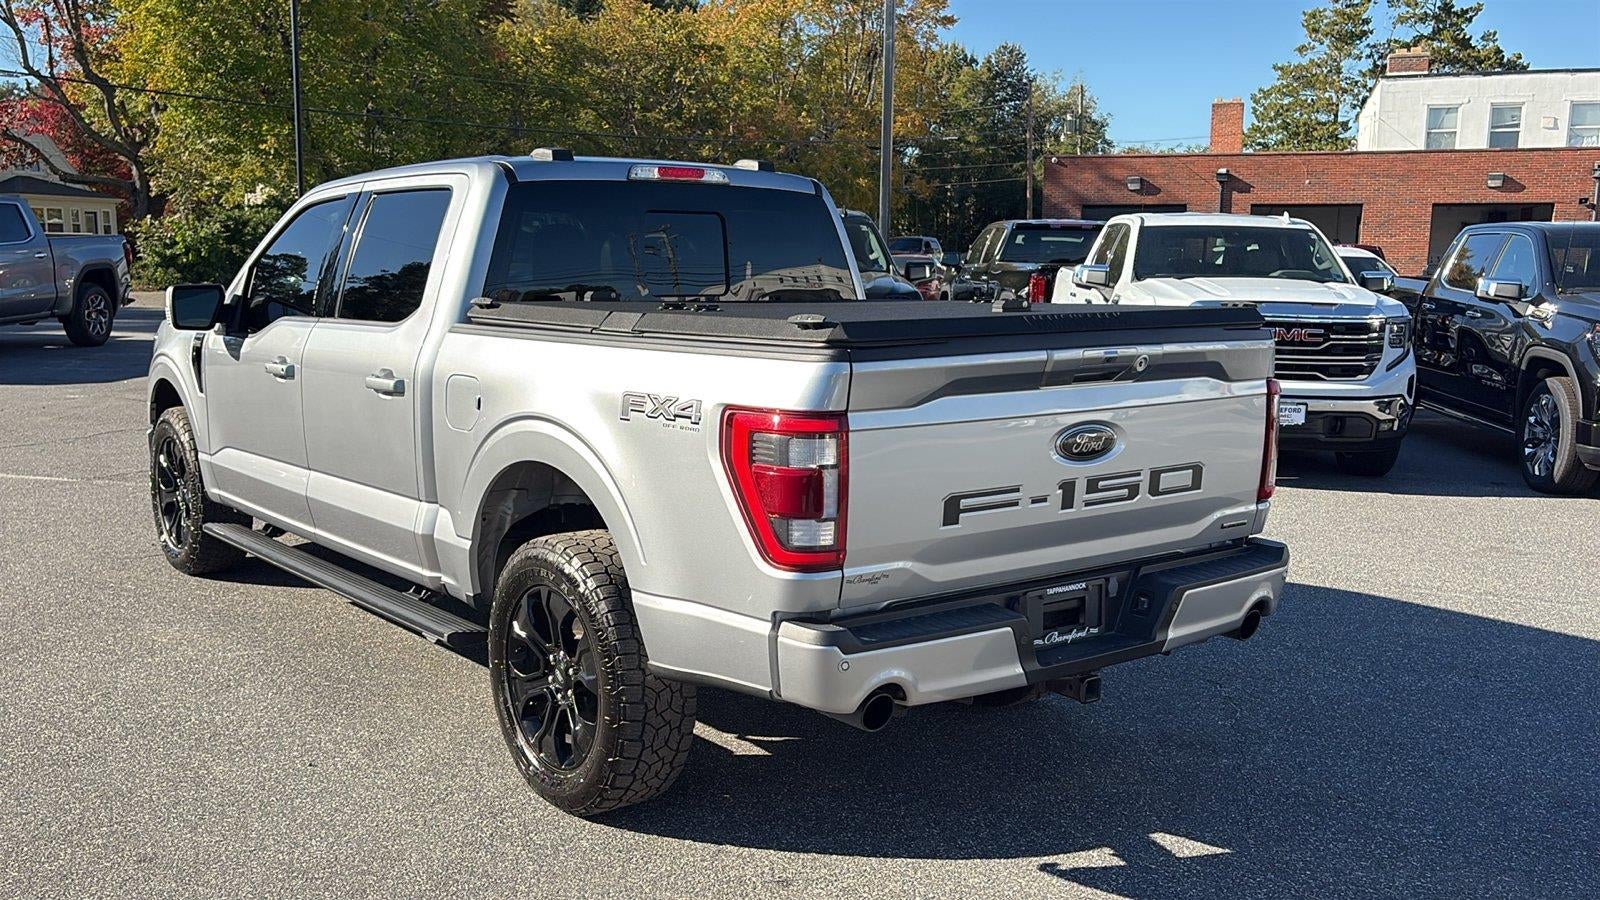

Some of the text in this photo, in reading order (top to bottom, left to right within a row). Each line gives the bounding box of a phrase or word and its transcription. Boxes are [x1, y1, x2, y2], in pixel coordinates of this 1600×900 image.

[1275, 327, 1324, 342] MC
[620, 391, 702, 425] FX4
[679, 425, 700, 433] ROAD
[1072, 433, 1106, 453] Ford
[940, 461, 1205, 528] F-150
[1046, 582, 1087, 595] TAPPAHANNOCK
